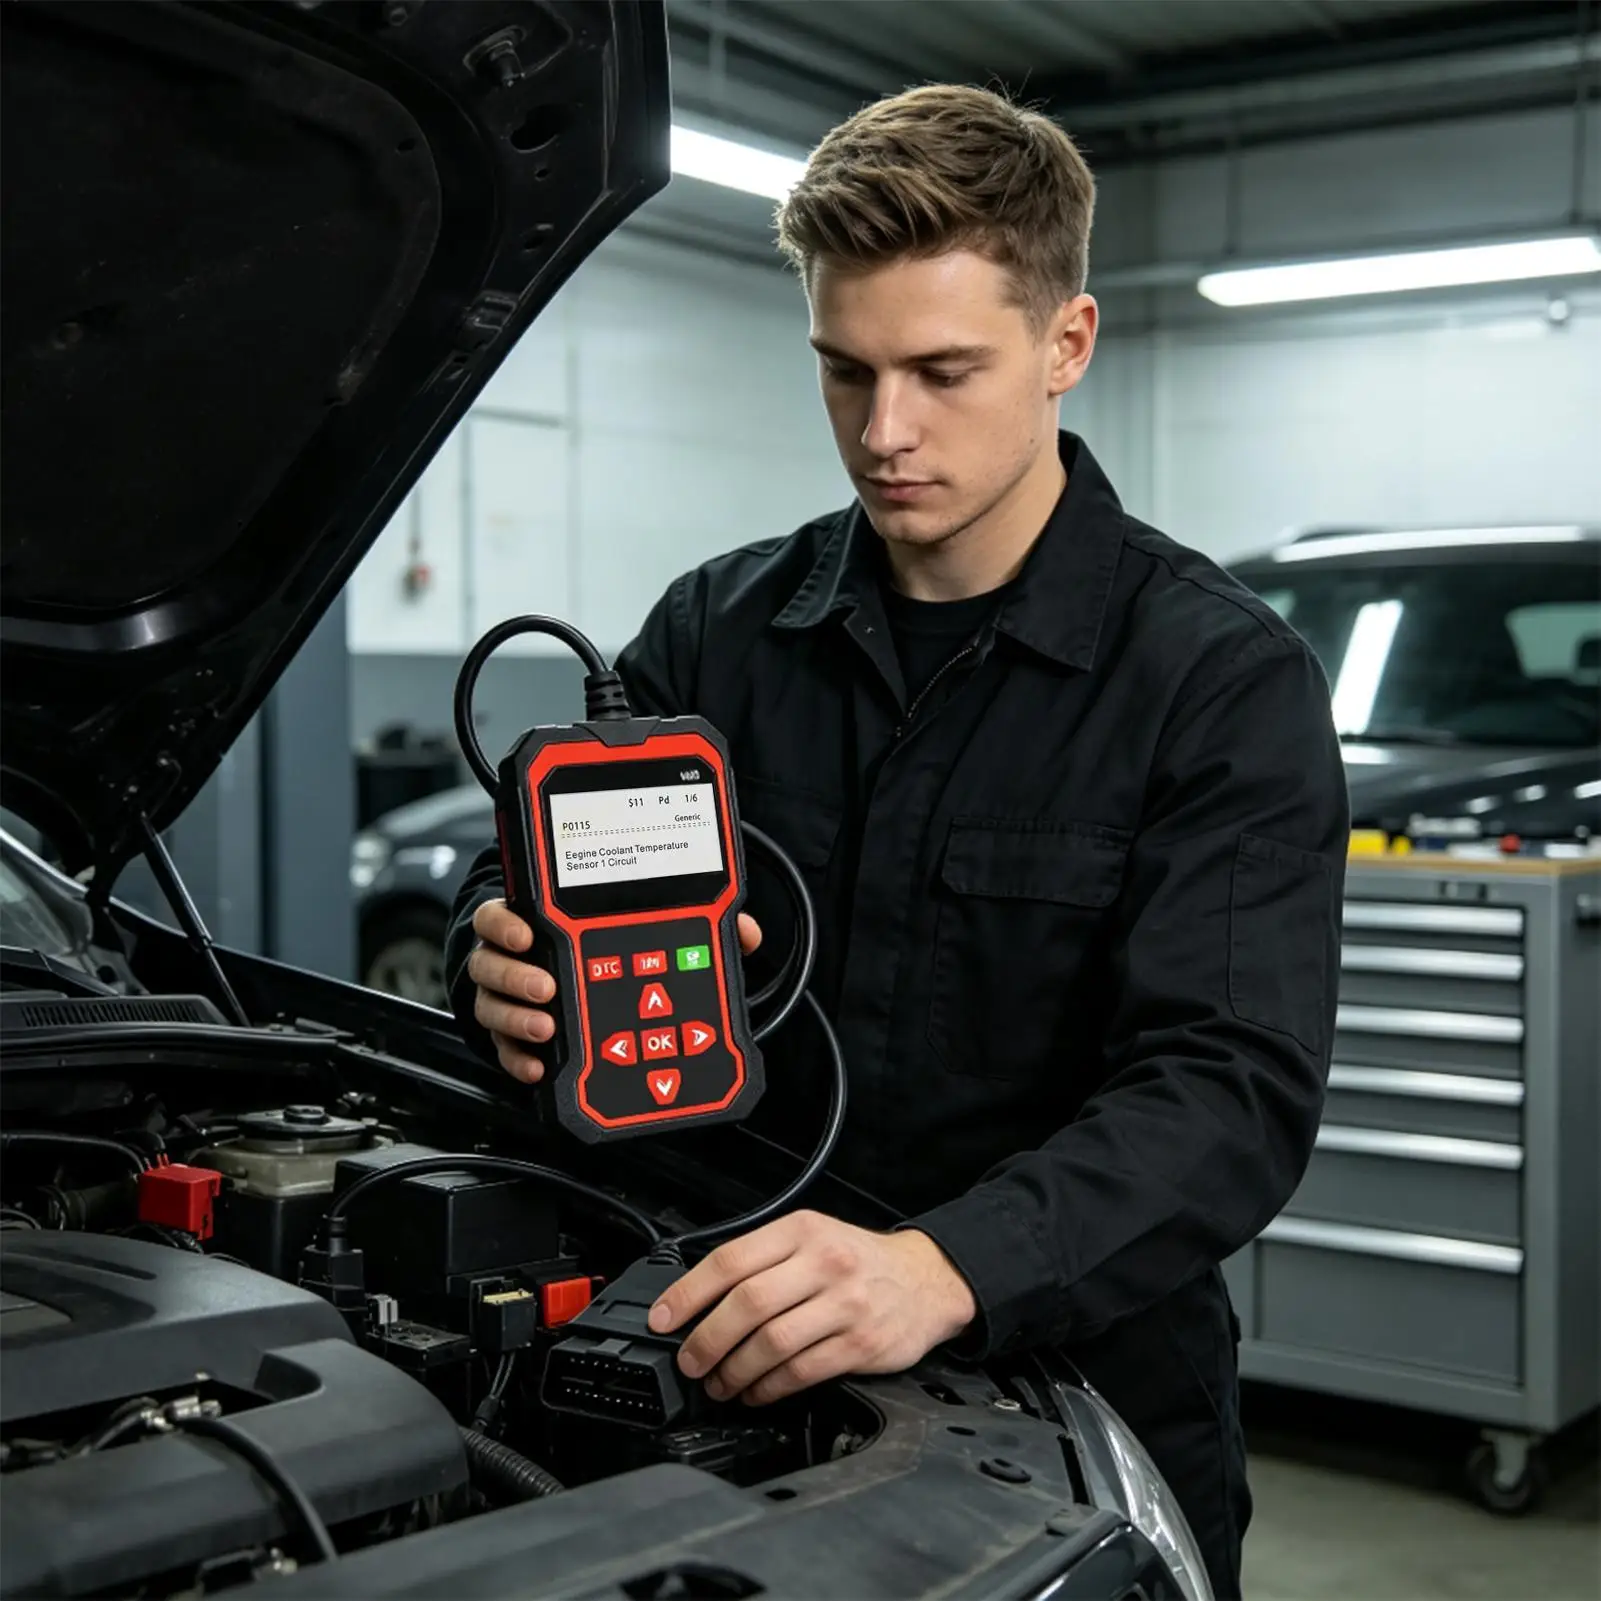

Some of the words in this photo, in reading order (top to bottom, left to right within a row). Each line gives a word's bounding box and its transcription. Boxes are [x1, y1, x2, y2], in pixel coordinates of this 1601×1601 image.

[628, 797, 644, 808] $11
[659, 796, 670, 805] Pd
[685, 794, 698, 803] 1/6
[674, 813, 701, 822] Generic
[562, 820, 591, 831] P0115
[599, 845, 634, 857] Coolant
[635, 841, 689, 854] Temperature
[566, 860, 599, 871] Sensor
[601, 859, 606, 868] 1
[607, 856, 637, 867] Circuit
[592, 961, 619, 977] DTC
[647, 1034, 673, 1051] OK
